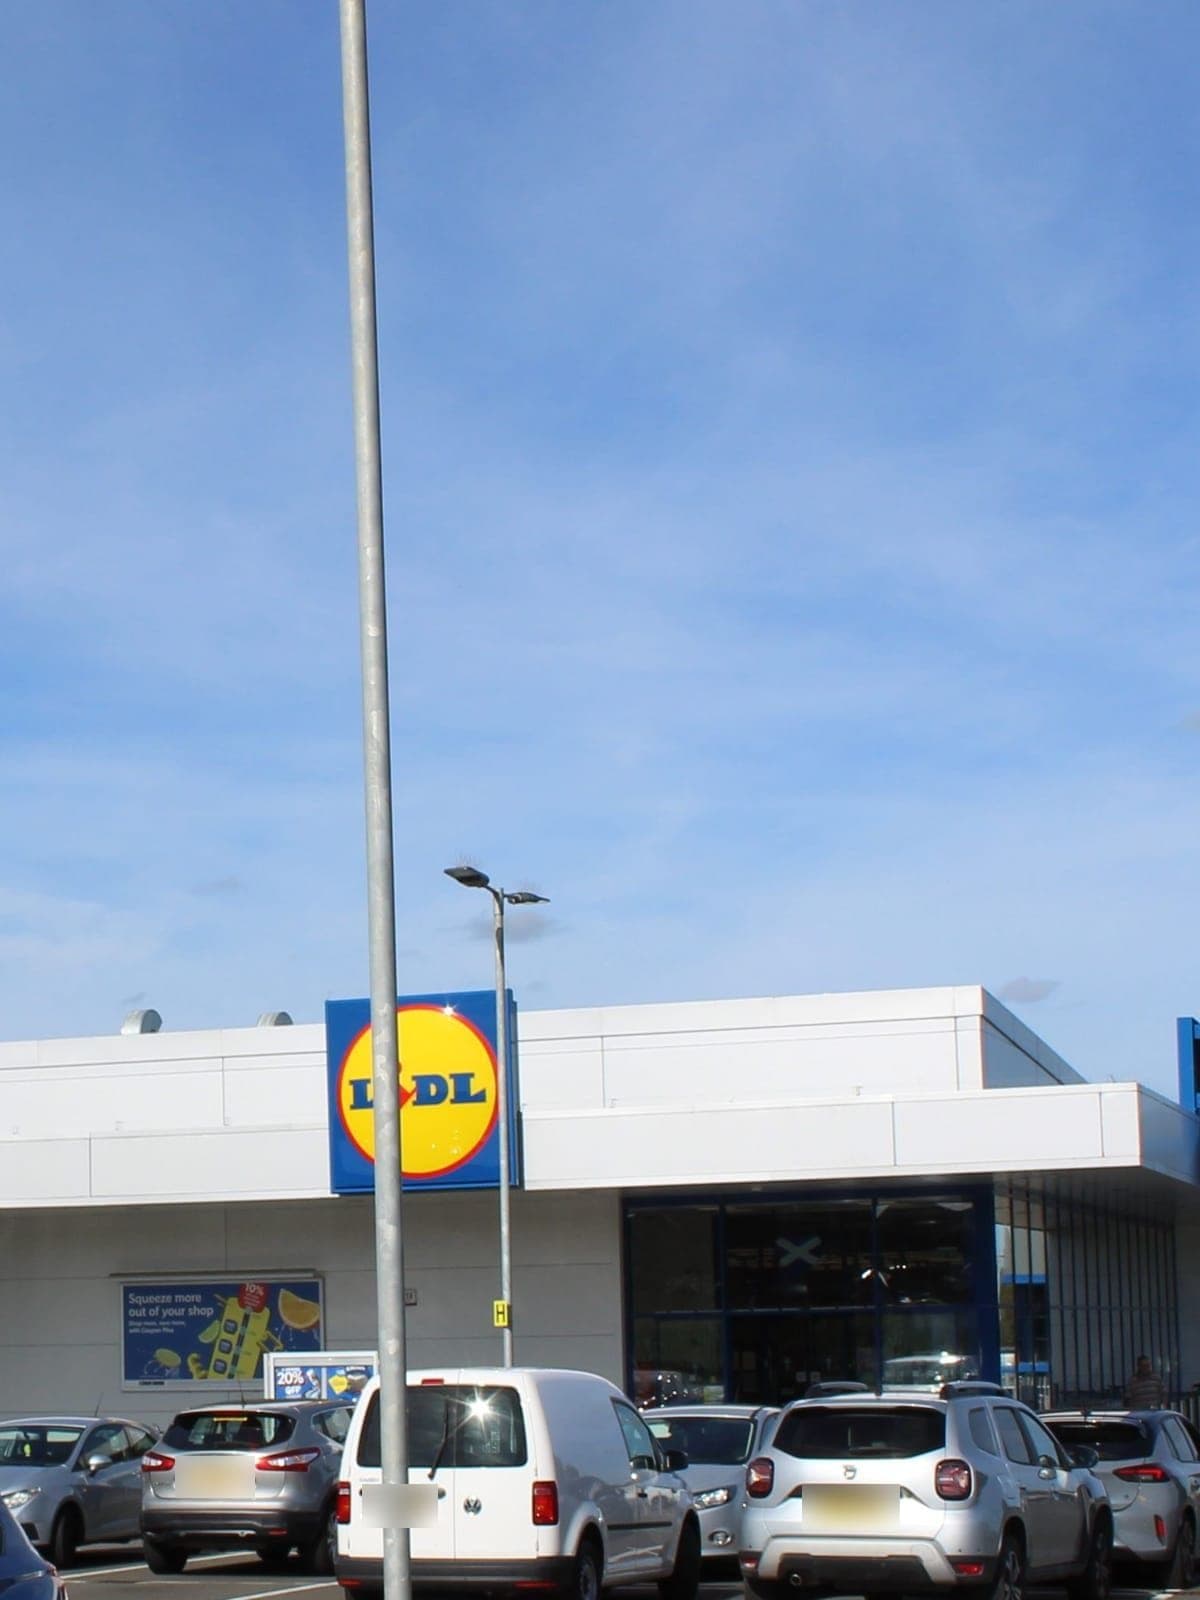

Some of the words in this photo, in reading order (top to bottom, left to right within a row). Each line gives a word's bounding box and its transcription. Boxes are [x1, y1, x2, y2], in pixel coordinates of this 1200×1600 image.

[349, 1072, 487, 1110] LDL
[128, 1293, 172, 1305] Squeeze
[174, 1293, 202, 1303] more
[128, 1307, 146, 1317] out
[148, 1305, 159, 1317] of
[161, 1306, 185, 1318] your
[187, 1304, 214, 1318] shop
[496, 1304, 506, 1324] H
[277, 1371, 305, 1385] 20%
